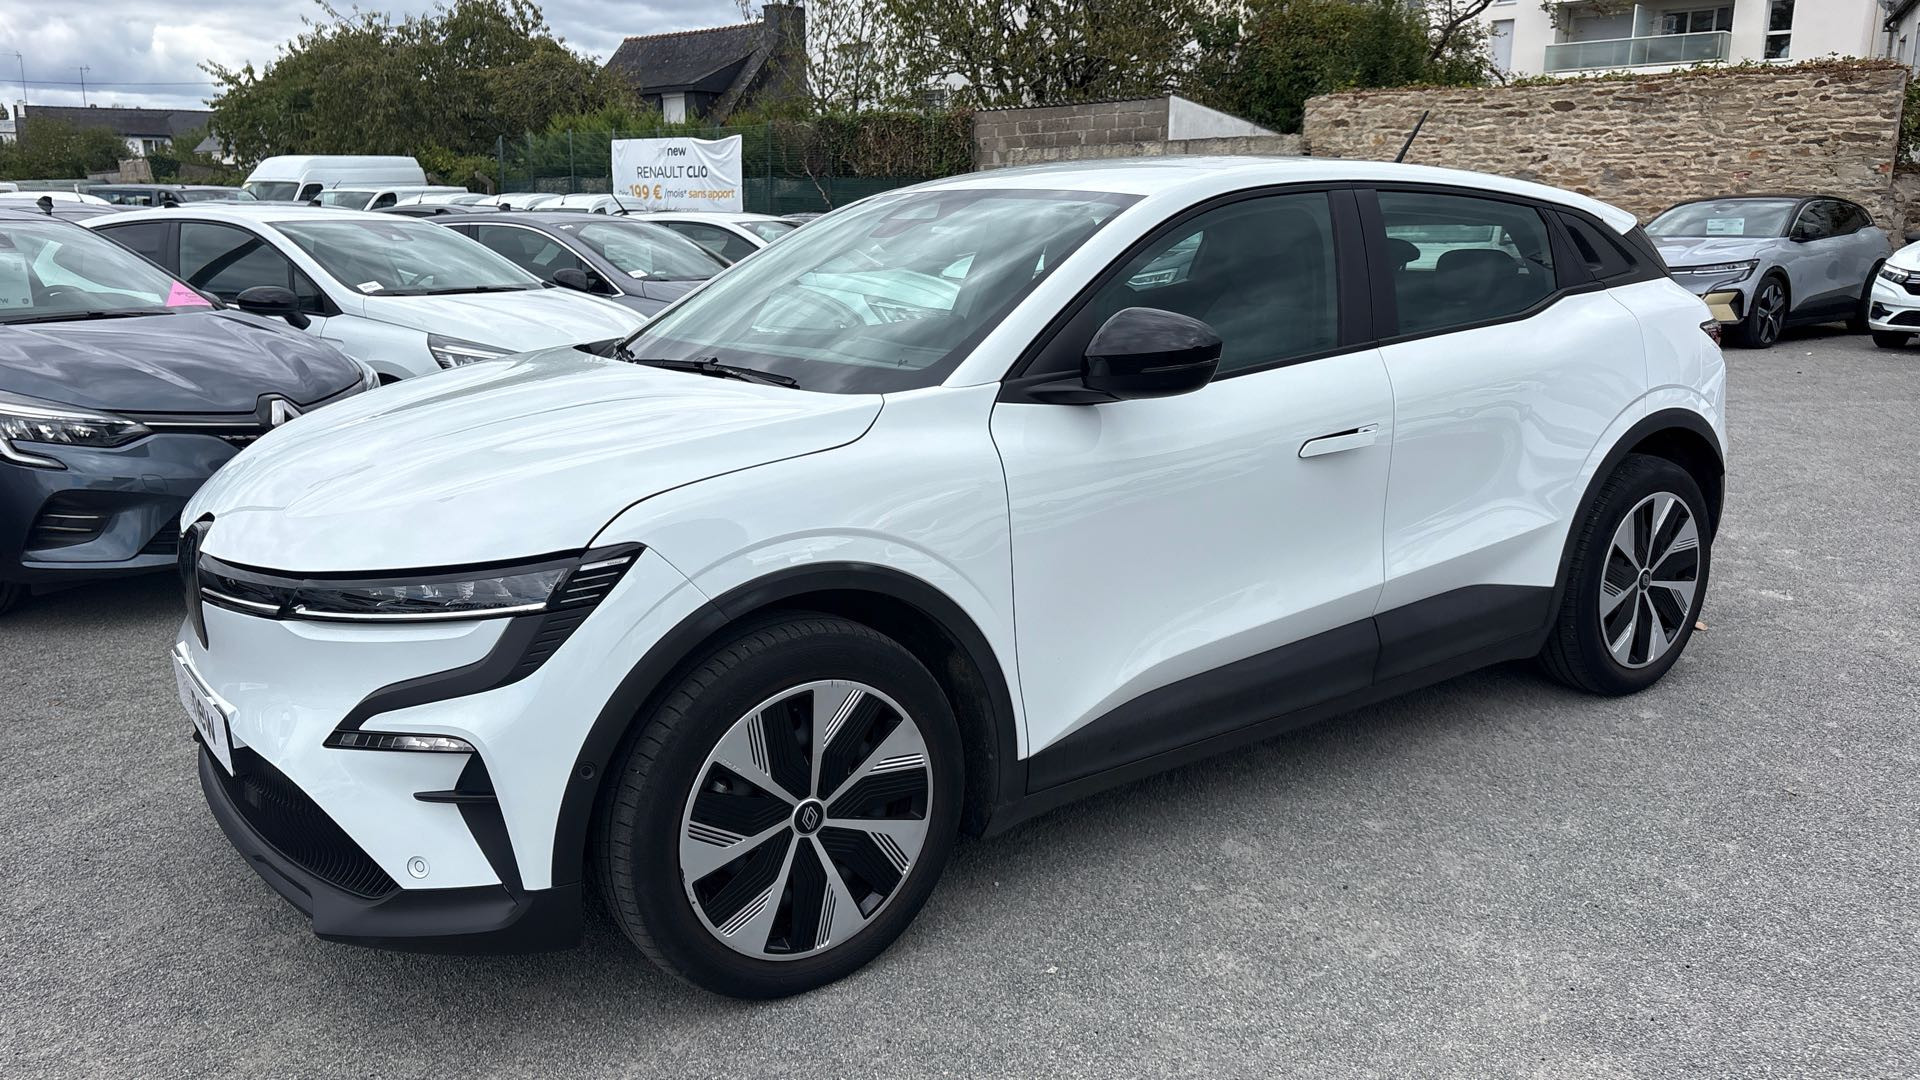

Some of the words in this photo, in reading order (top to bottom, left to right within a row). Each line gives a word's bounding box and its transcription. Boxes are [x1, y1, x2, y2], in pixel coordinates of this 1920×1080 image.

[667, 147, 686, 156] new
[637, 166, 684, 178] RENAULT
[687, 165, 708, 178] CLIO
[629, 184, 650, 200] 199
[653, 184, 663, 200] €
[688, 190, 707, 199] sans
[708, 189, 735, 201] apport
